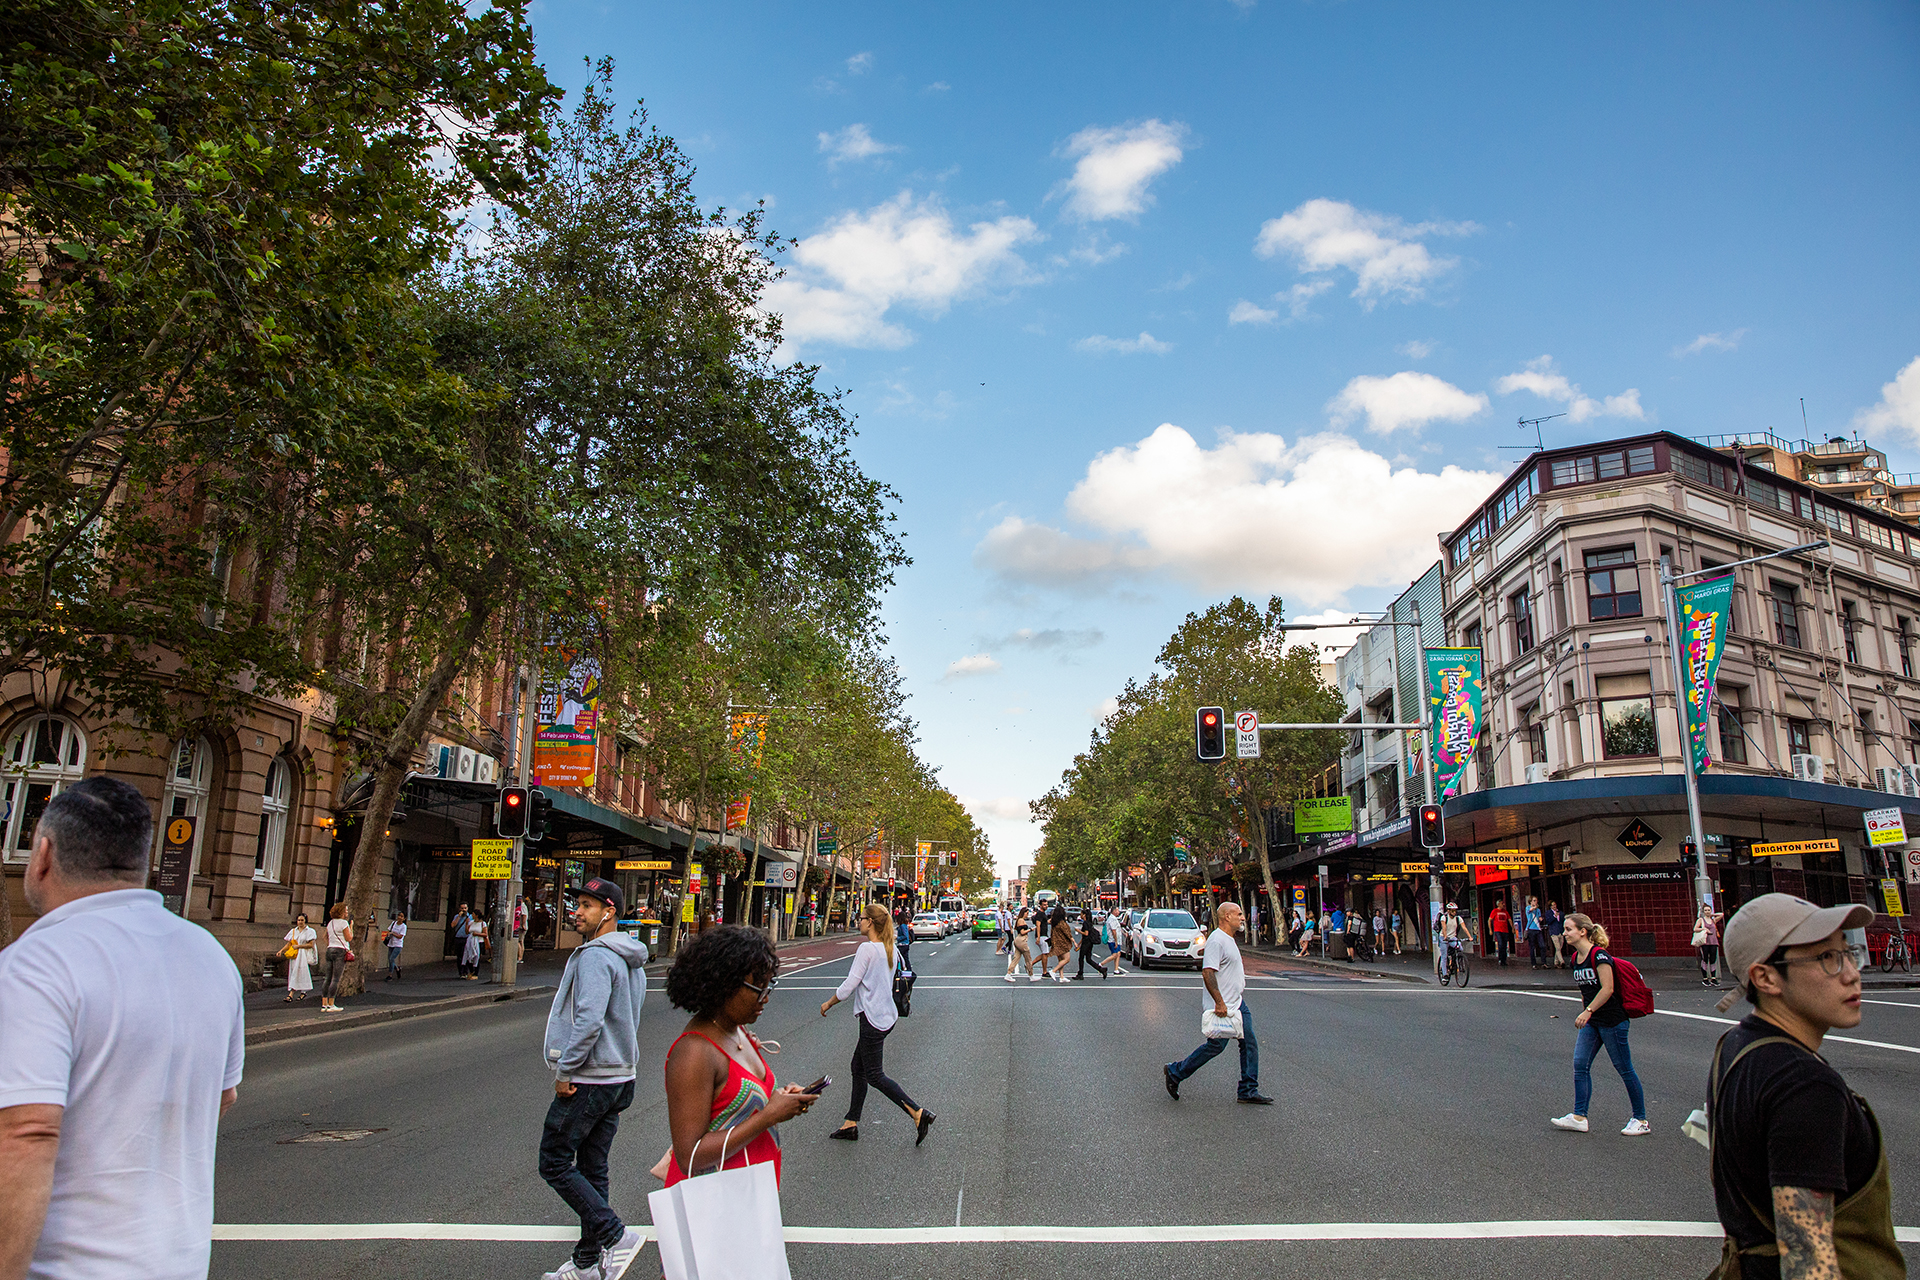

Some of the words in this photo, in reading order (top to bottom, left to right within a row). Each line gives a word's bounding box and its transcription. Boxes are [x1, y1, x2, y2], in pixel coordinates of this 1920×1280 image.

[1694, 591, 1713, 600] MARDI
[1713, 587, 1730, 595] GRAS
[1241, 734, 1254, 742] NO
[1319, 799, 1348, 808] LEASE
[1865, 809, 1897, 817] CLEARWAY
[1754, 844, 1802, 854] BRIGHTON
[1805, 841, 1836, 850] HOTEL
